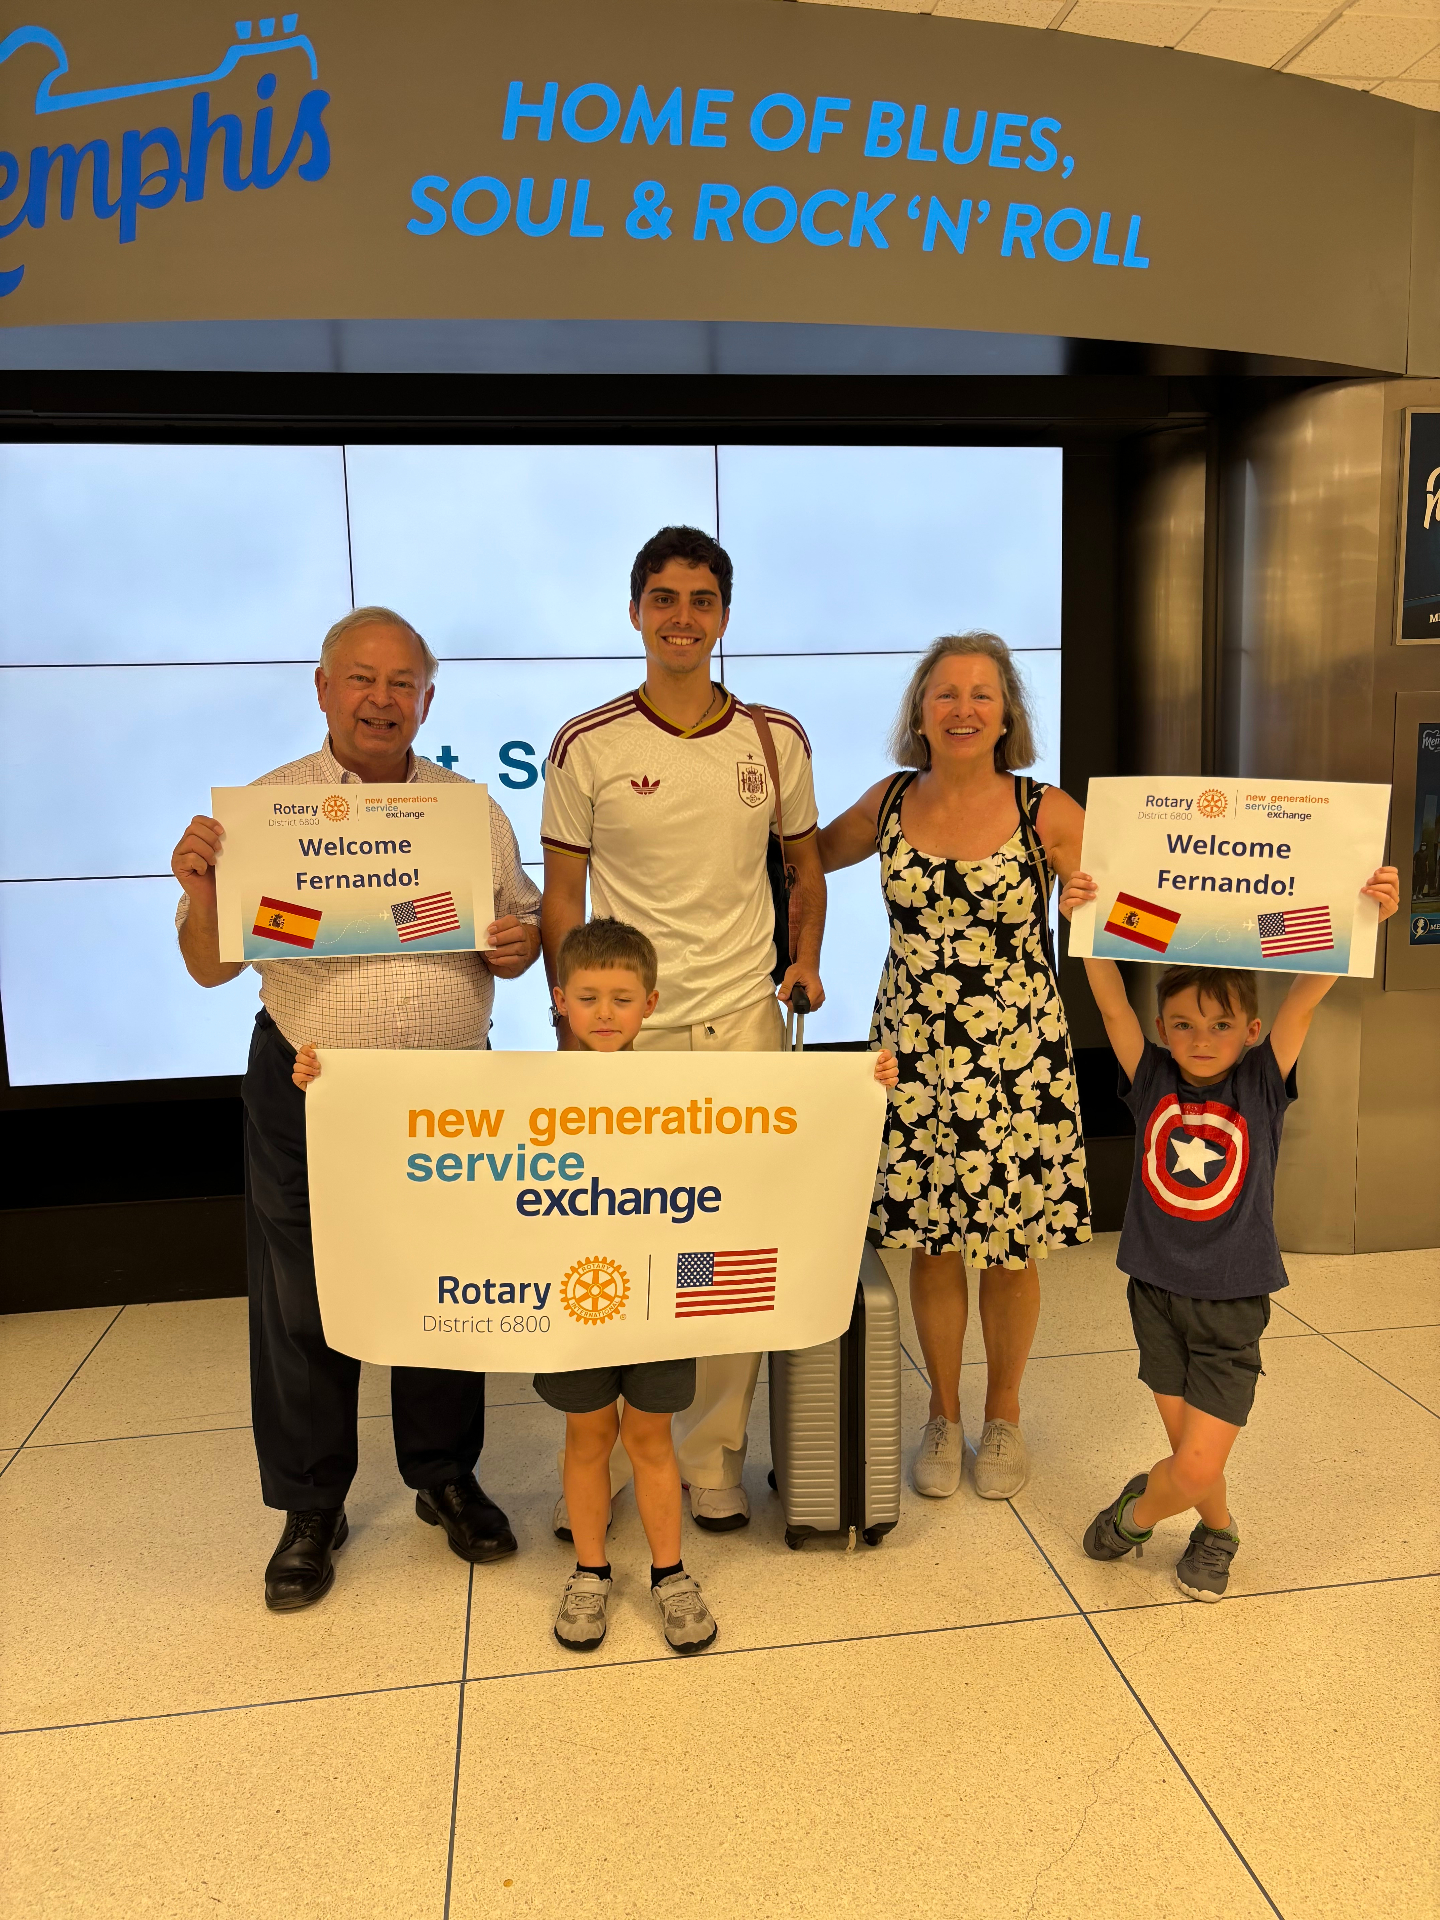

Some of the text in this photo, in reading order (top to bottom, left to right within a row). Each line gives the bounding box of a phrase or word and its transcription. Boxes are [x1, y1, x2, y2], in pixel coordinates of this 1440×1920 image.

[502, 80, 1075, 180] HOME OF BLUES,
[0, 73, 331, 297] emphis
[406, 174, 605, 238] SOUL
[625, 180, 673, 241] &
[692, 183, 897, 250] ROCK
[1001, 203, 1150, 270] ROLL
[365, 795, 438, 805] new generations
[365, 804, 399, 813] service
[1145, 794, 1194, 811] Rotary
[1244, 801, 1283, 812] service
[1245, 794, 1330, 805] new generations
[273, 803, 319, 817] Rotary
[385, 809, 425, 820] exchange
[1137, 811, 1168, 820] District
[1169, 811, 1193, 821] 6800
[1266, 809, 1312, 822] exchange
[268, 818, 297, 827] District
[298, 836, 412, 858] Welcome
[1166, 833, 1292, 860] Welcome
[296, 868, 420, 891] Fernando!
[1157, 869, 1296, 897] Fernando!
[408, 1097, 798, 1147] new generations
[406, 1143, 585, 1183] service
[515, 1176, 722, 1225] exchange
[581, 1263, 611, 1272] ROTARY
[437, 1275, 552, 1311] Rotary
[570, 1299, 620, 1318] INTERNATIONAL
[422, 1315, 551, 1334] District 6800
